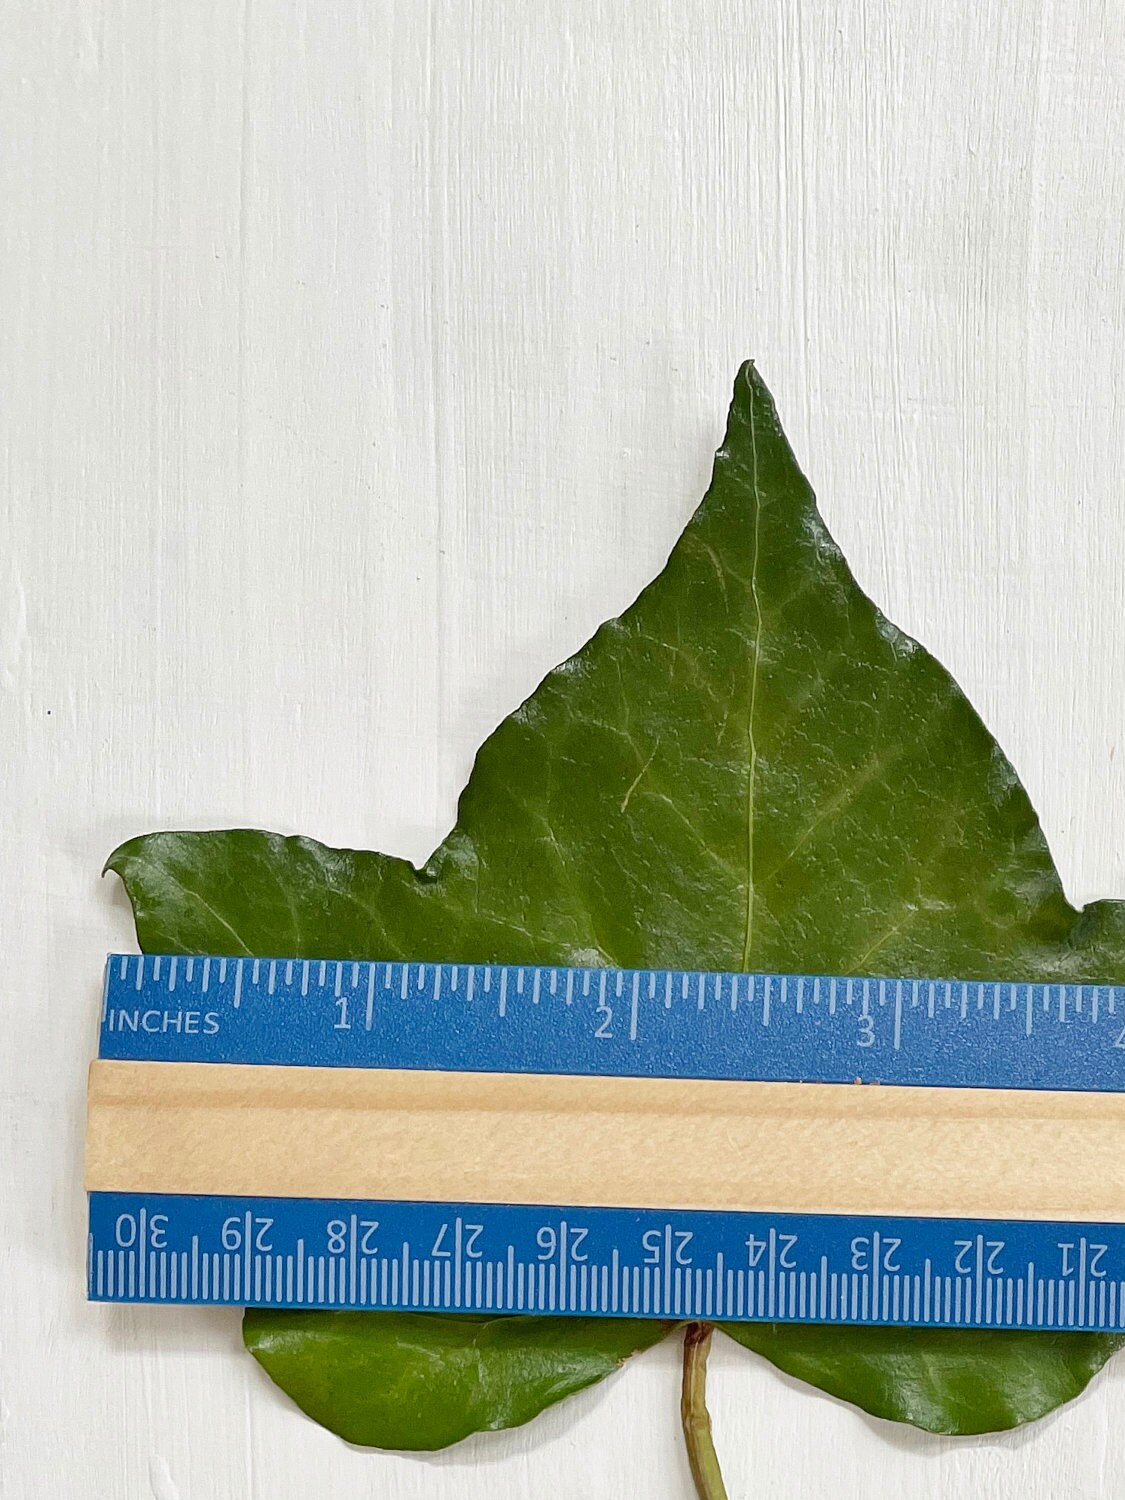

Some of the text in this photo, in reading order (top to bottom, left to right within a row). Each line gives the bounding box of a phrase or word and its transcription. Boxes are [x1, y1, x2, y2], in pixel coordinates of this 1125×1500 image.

[107, 1008, 221, 1035] INCHES
[333, 997, 352, 1030] 1
[594, 1006, 613, 1039] 2
[856, 1015, 875, 1048] 3
[115, 1213, 168, 1249] 30
[222, 1217, 274, 1252] 29
[327, 1220, 379, 1255] 28
[431, 1223, 484, 1258] 27
[536, 1226, 588, 1262] 26
[643, 1230, 694, 1265] 25
[745, 1233, 798, 1268] 24
[850, 1237, 902, 1272] 23
[953, 1240, 1005, 1275] 22
[1057, 1243, 1108, 1278] 21
